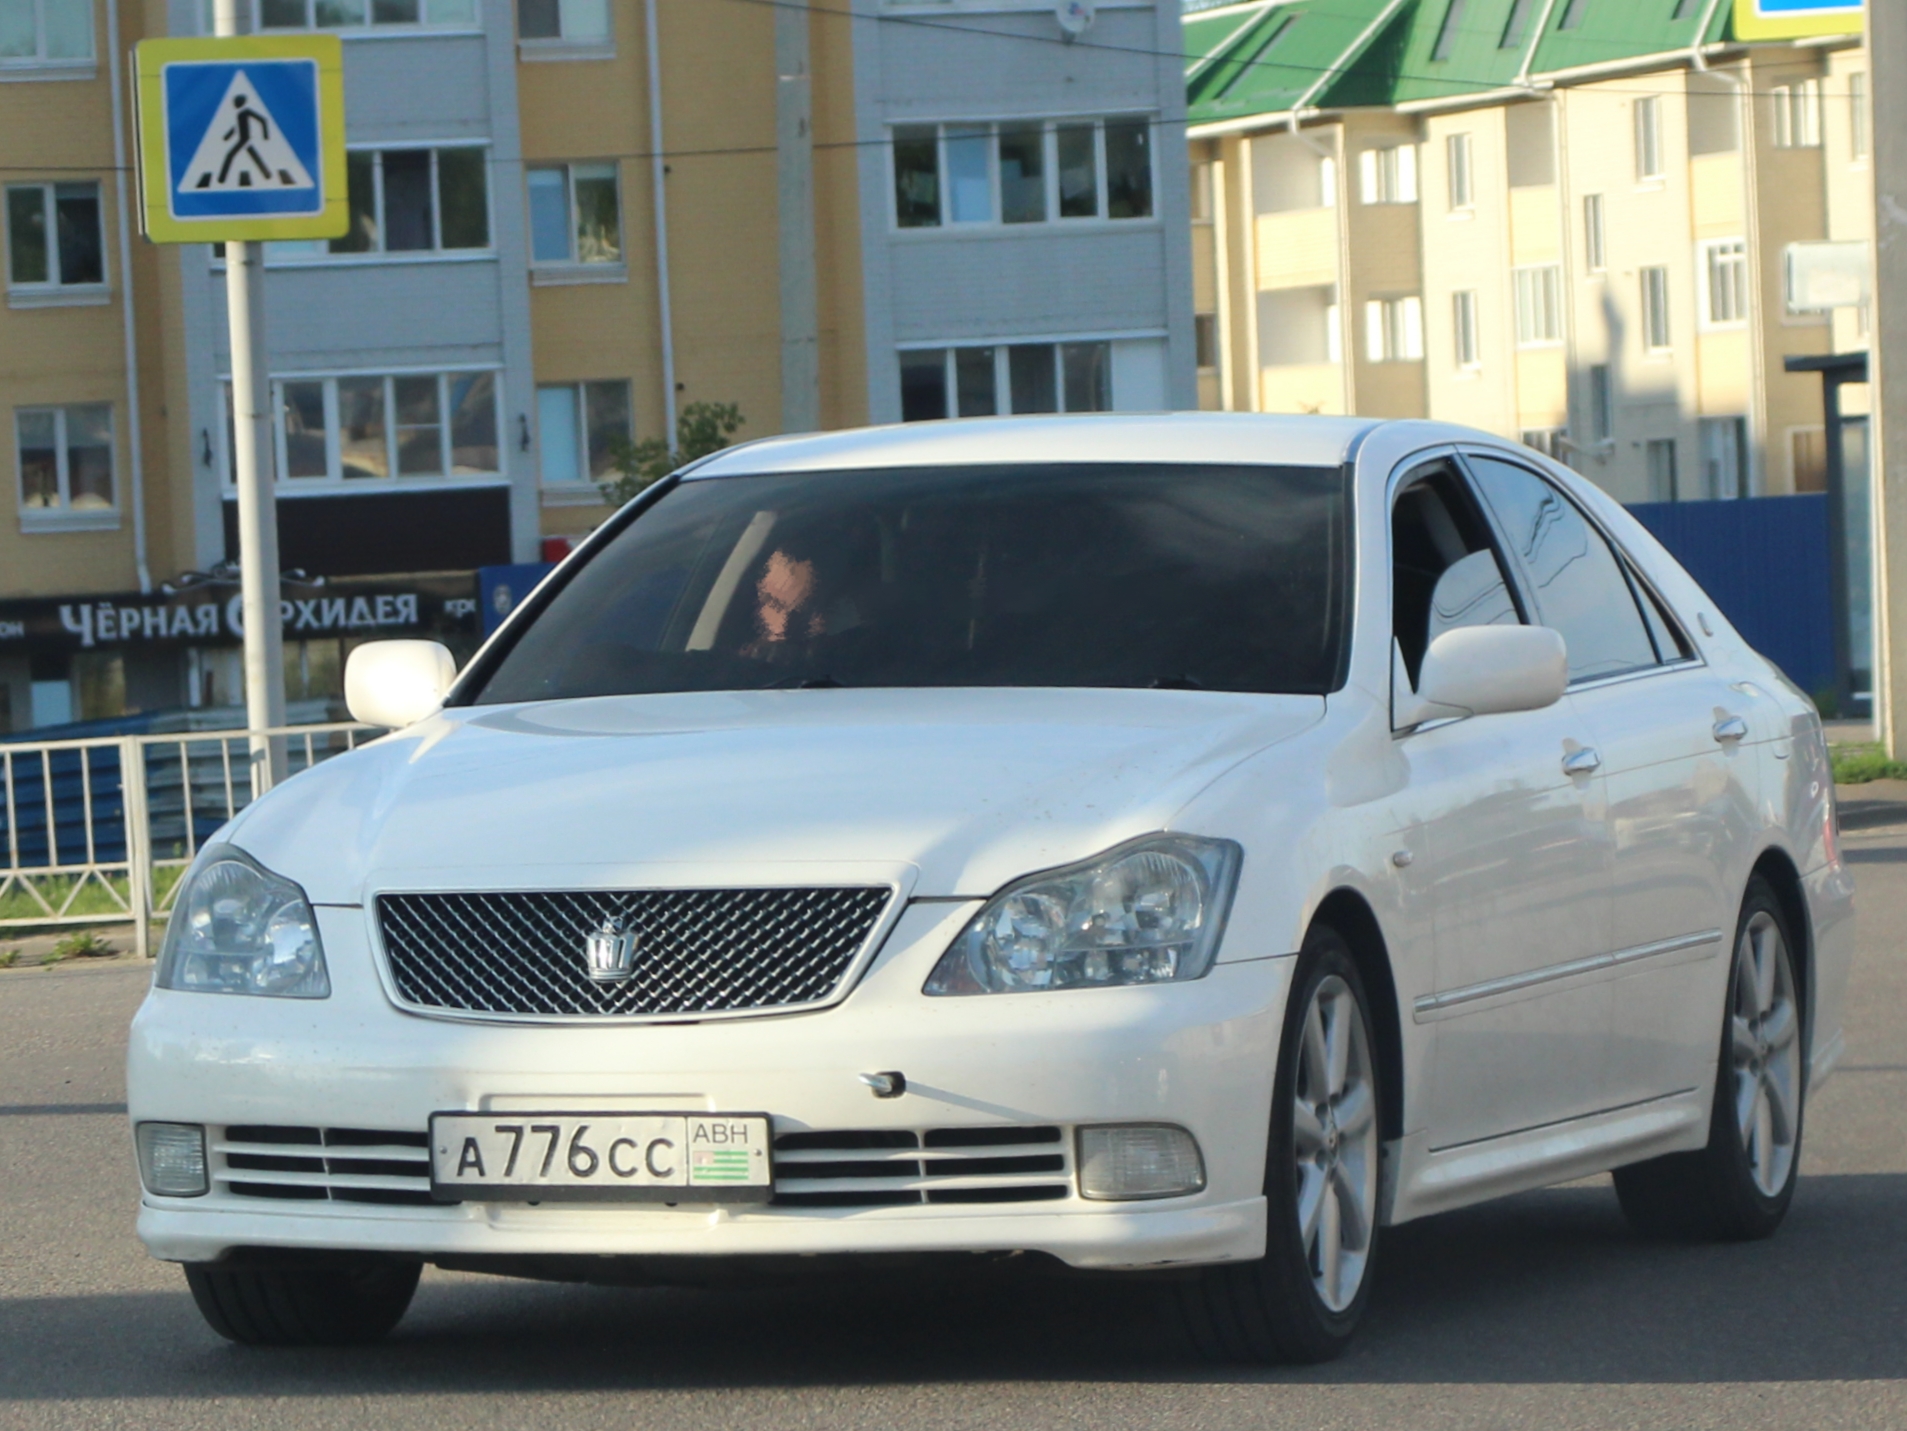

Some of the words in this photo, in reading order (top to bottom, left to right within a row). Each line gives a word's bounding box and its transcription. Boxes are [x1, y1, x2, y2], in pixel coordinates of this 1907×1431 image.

[60, 602, 219, 647] ЧЁРНАЯ
[456, 1125, 675, 1178] A776CC
[693, 1123, 749, 1144] ABH
